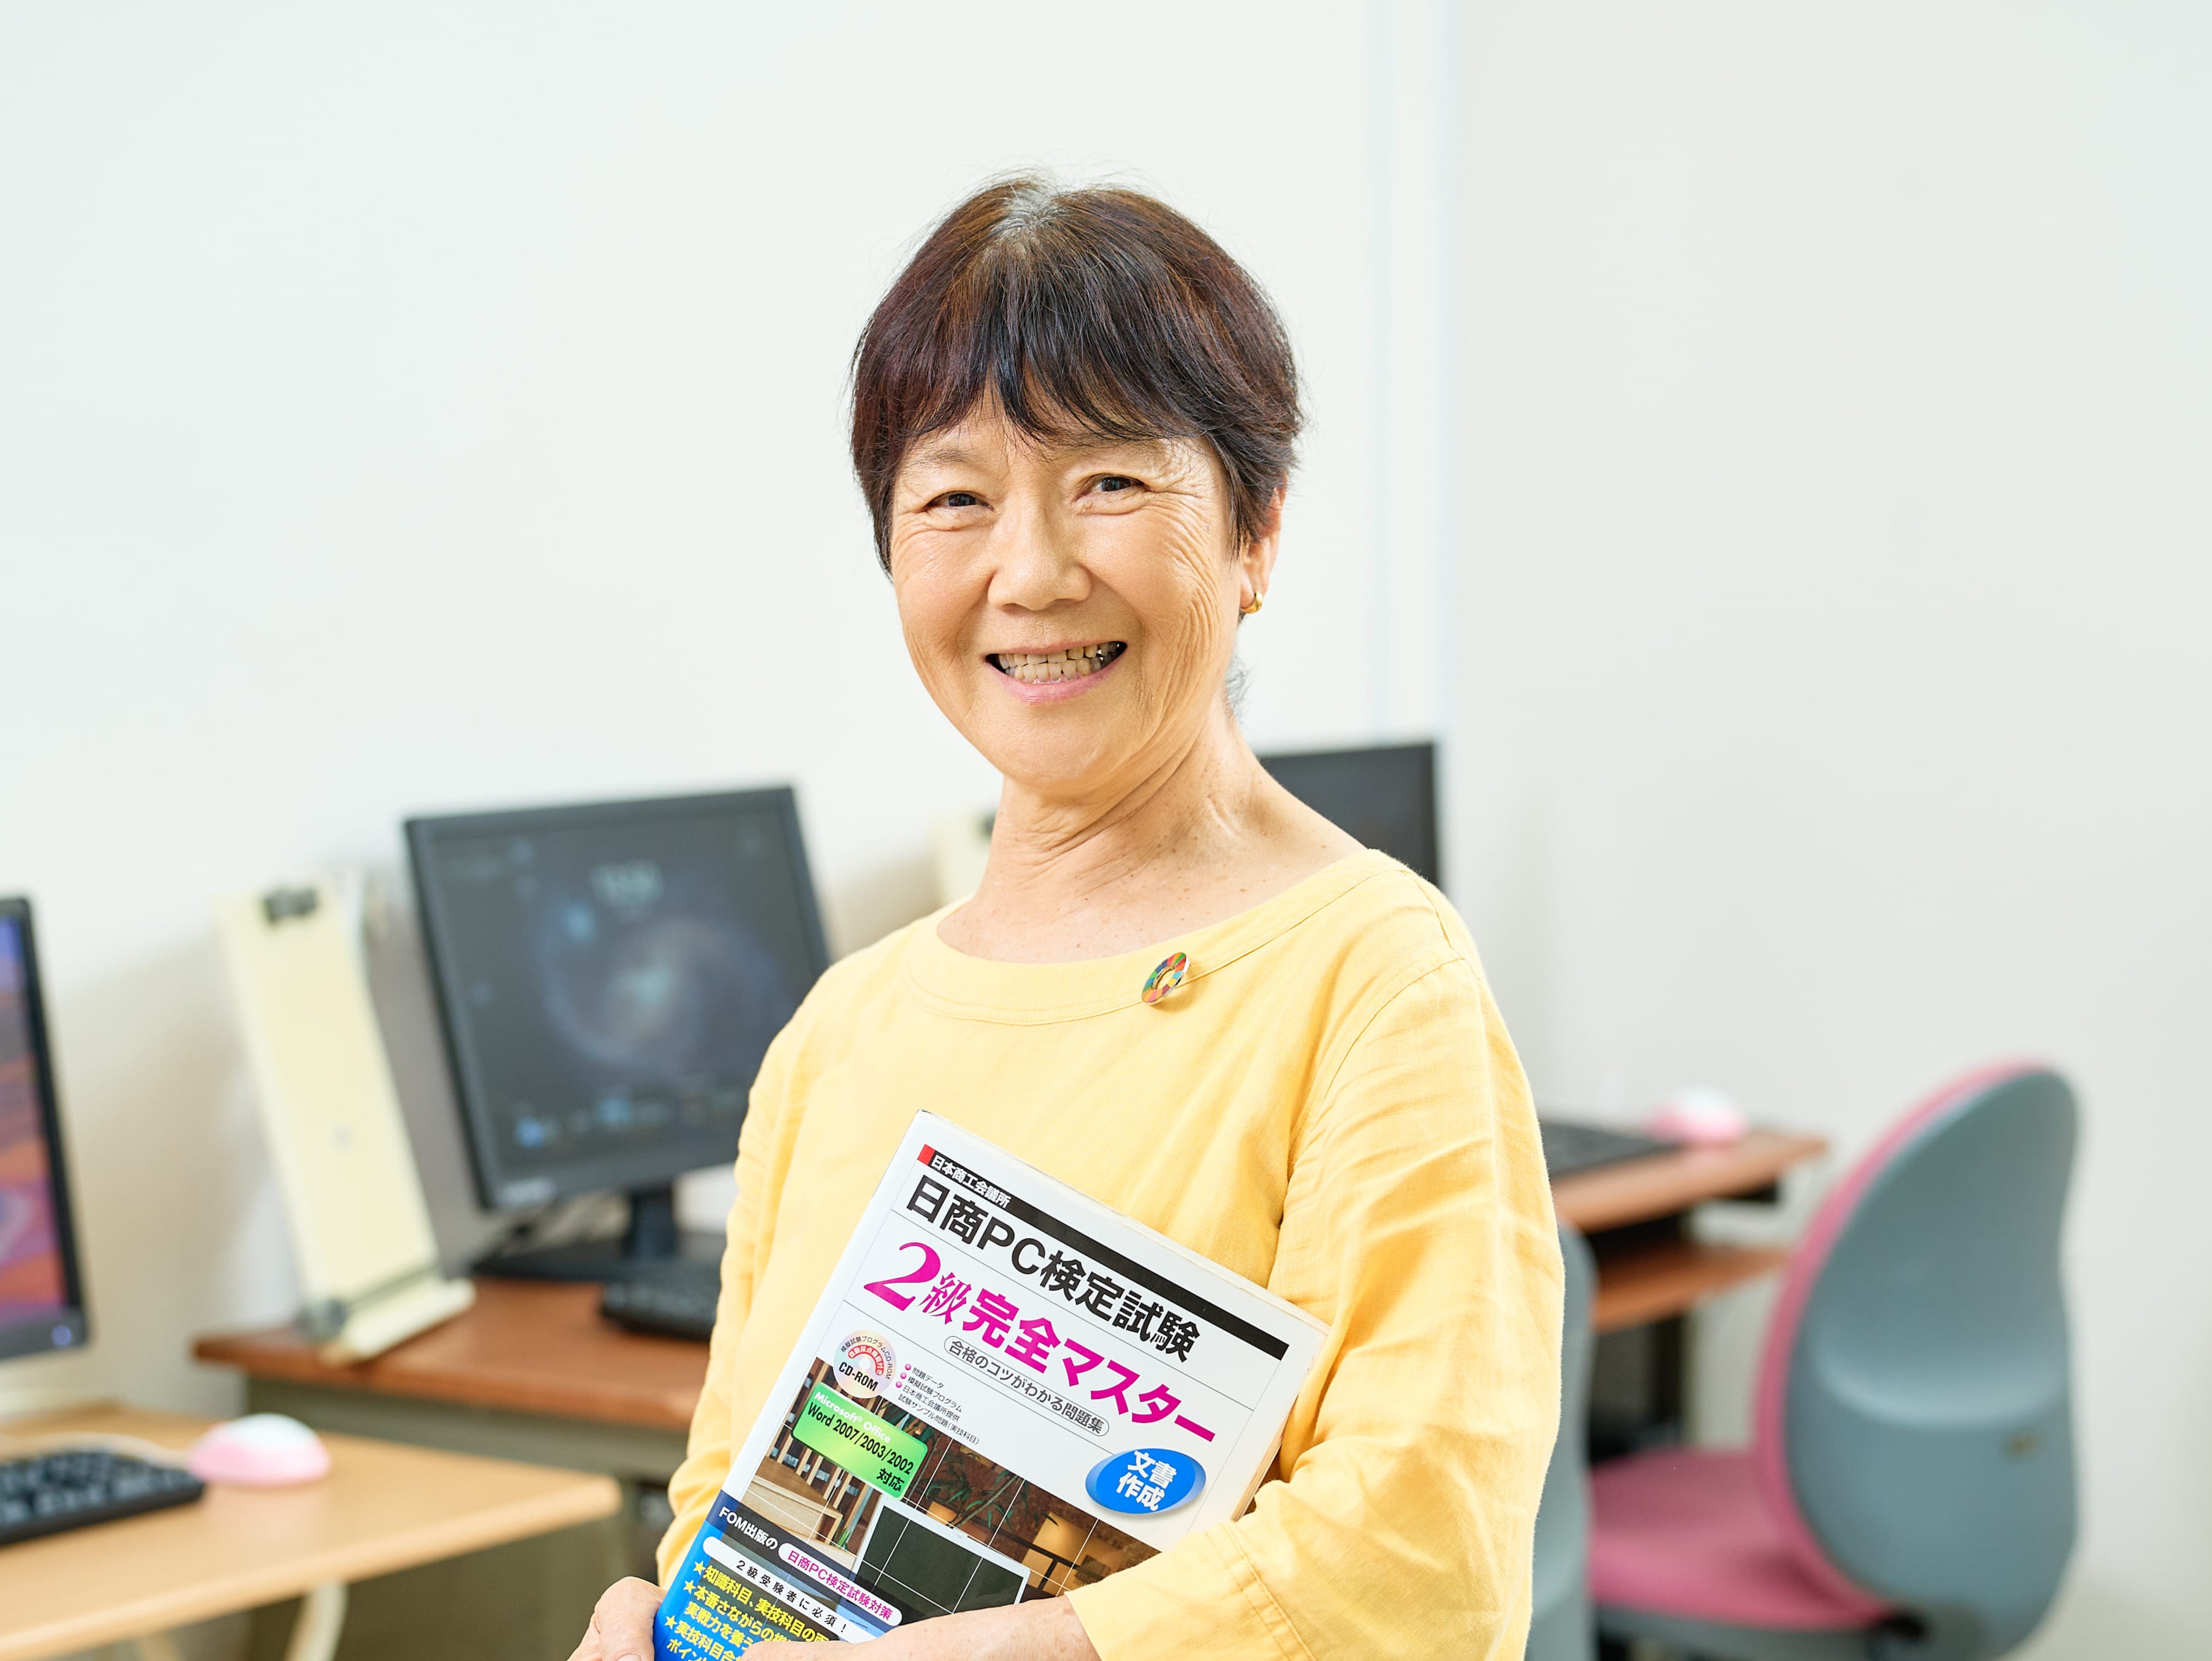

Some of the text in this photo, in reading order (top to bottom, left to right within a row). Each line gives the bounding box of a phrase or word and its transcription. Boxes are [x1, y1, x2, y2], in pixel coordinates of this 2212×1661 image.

[931, 1154, 1012, 1209] 日本商工会議所
[906, 1174, 1200, 1363] 日商PC検定試験
[864, 1242, 1216, 1443] 2級完全マスター
[838, 1362, 878, 1391] CD-ROM
[907, 1376, 962, 1412] 模擬試験プログラム
[912, 1367, 944, 1388] 問題データ
[948, 1339, 1105, 1435] 合格のコツがわかる問題集
[903, 1384, 960, 1422] 日本商工会議所提供
[807, 1402, 915, 1475] Word 2007/2003/2002
[863, 1422, 891, 1443] Office
[876, 1468, 905, 1492] 対応
[1127, 1450, 1177, 1489] 文書
[1116, 1472, 1165, 1511] 作成
[719, 1507, 893, 1621] FOM出版の 日商PC検定試験対策
[667, 1639, 707, 1661] ポイン
[674, 1619, 741, 1661] 実技科目合
